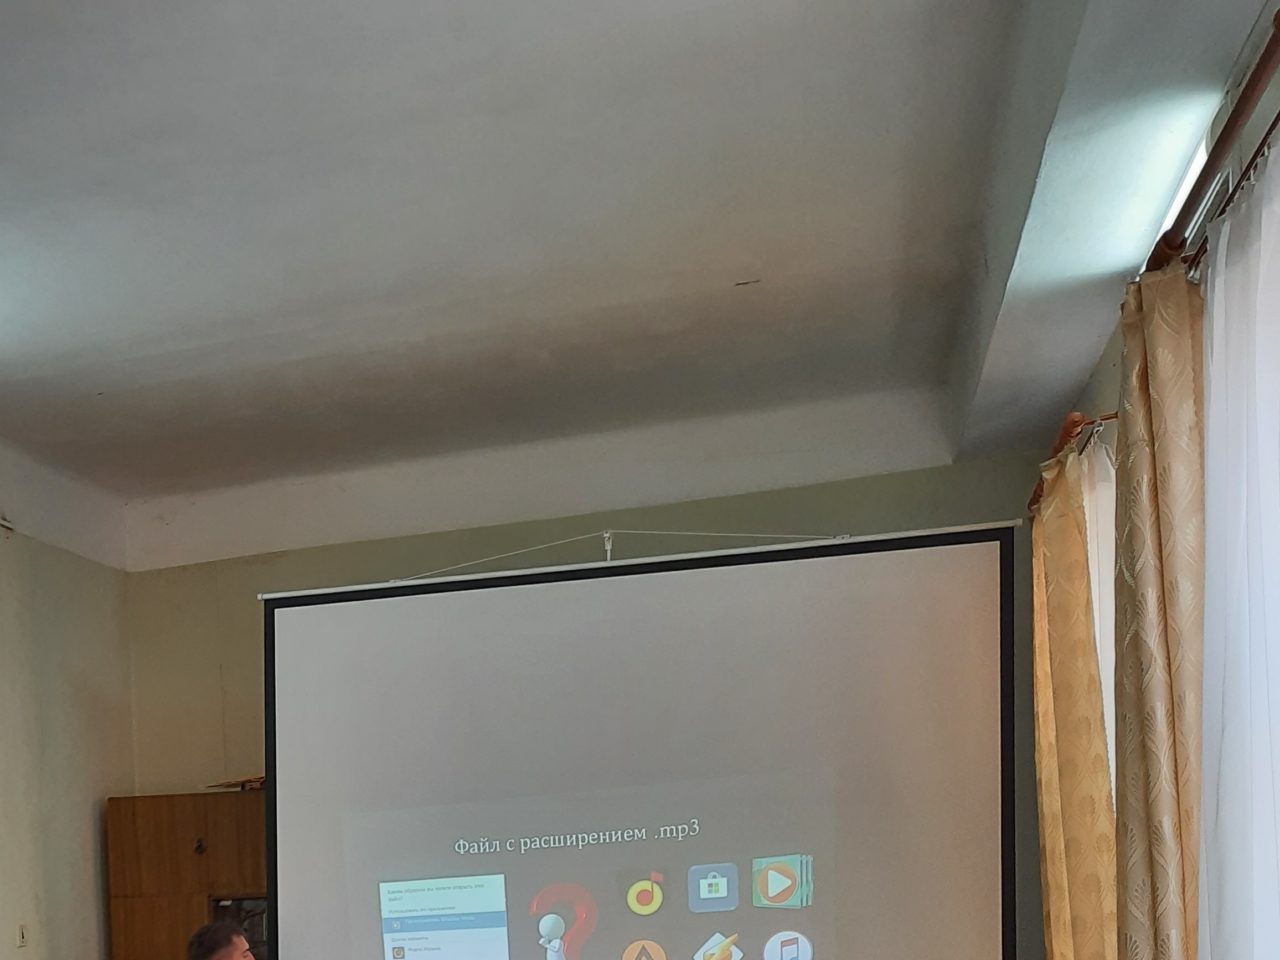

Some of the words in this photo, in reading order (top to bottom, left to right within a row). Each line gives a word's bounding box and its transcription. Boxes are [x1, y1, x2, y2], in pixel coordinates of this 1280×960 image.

[454, 838, 501, 855] Файл
[506, 838, 515, 851] с
[520, 827, 647, 853] расширением
[653, 818, 700, 841] .mp3
